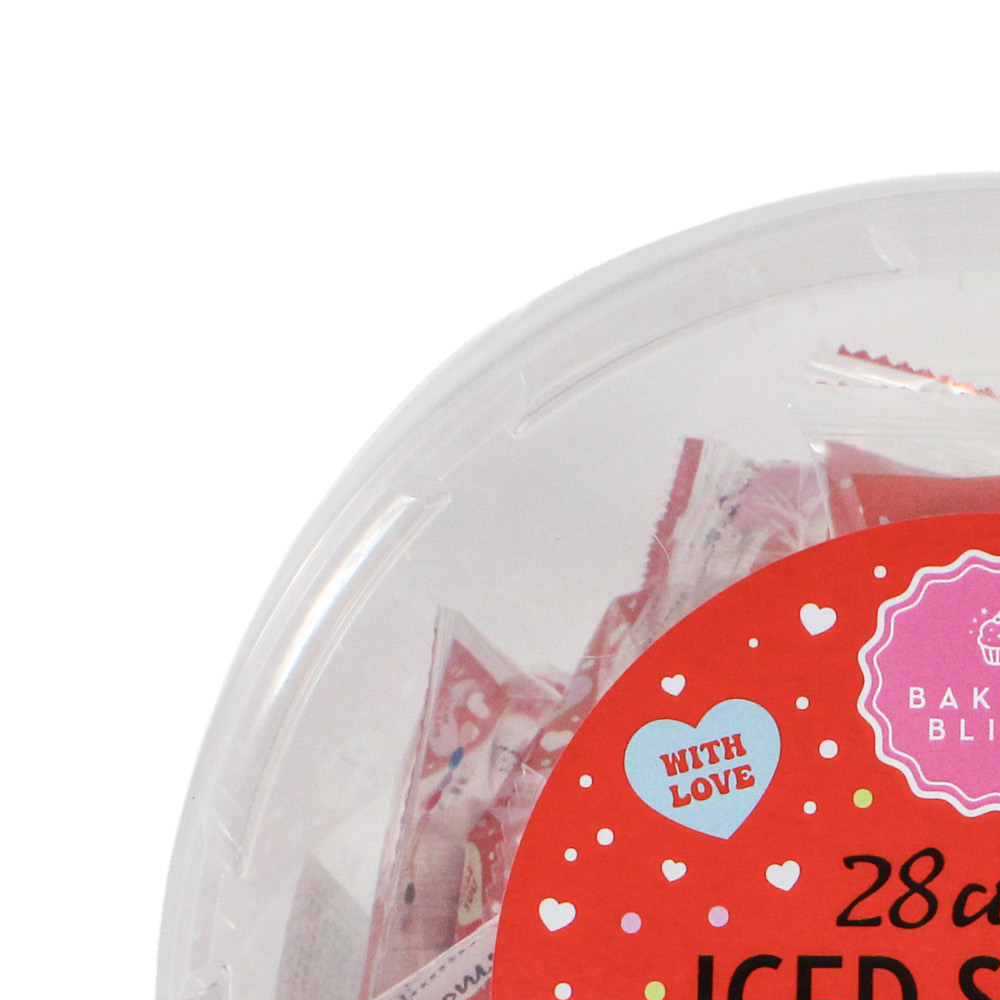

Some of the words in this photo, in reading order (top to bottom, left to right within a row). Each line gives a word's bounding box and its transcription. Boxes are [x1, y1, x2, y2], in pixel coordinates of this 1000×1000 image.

[660, 733, 747, 777] WITH
[669, 764, 756, 808] LOVE
[837, 847, 945, 929] 28
